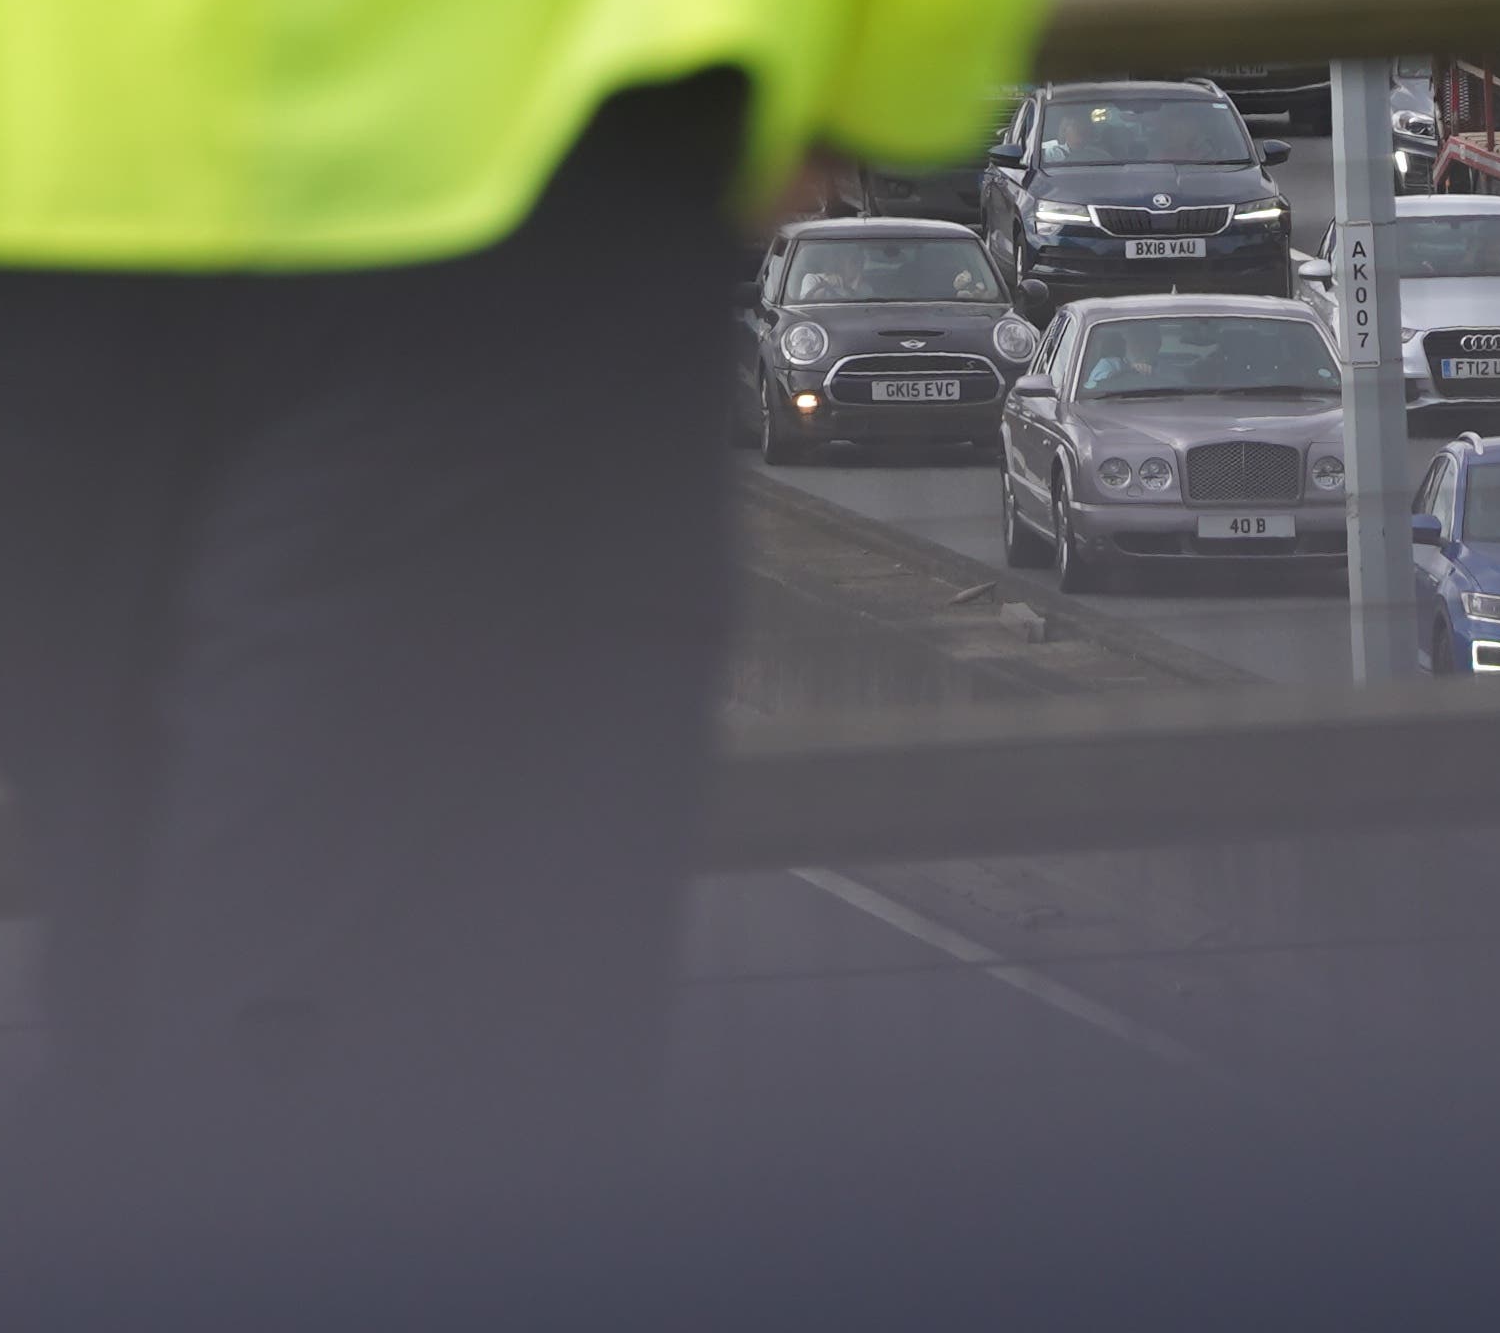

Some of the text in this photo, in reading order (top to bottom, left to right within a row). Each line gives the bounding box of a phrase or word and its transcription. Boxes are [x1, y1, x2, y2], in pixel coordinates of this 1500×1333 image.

[1135, 240, 1197, 257] BX18 VAU
[1351, 240, 1370, 348] AK007
[1455, 360, 1489, 376] FT12
[885, 382, 955, 398] GK15 EVC
[1229, 517, 1267, 534] 40 B
